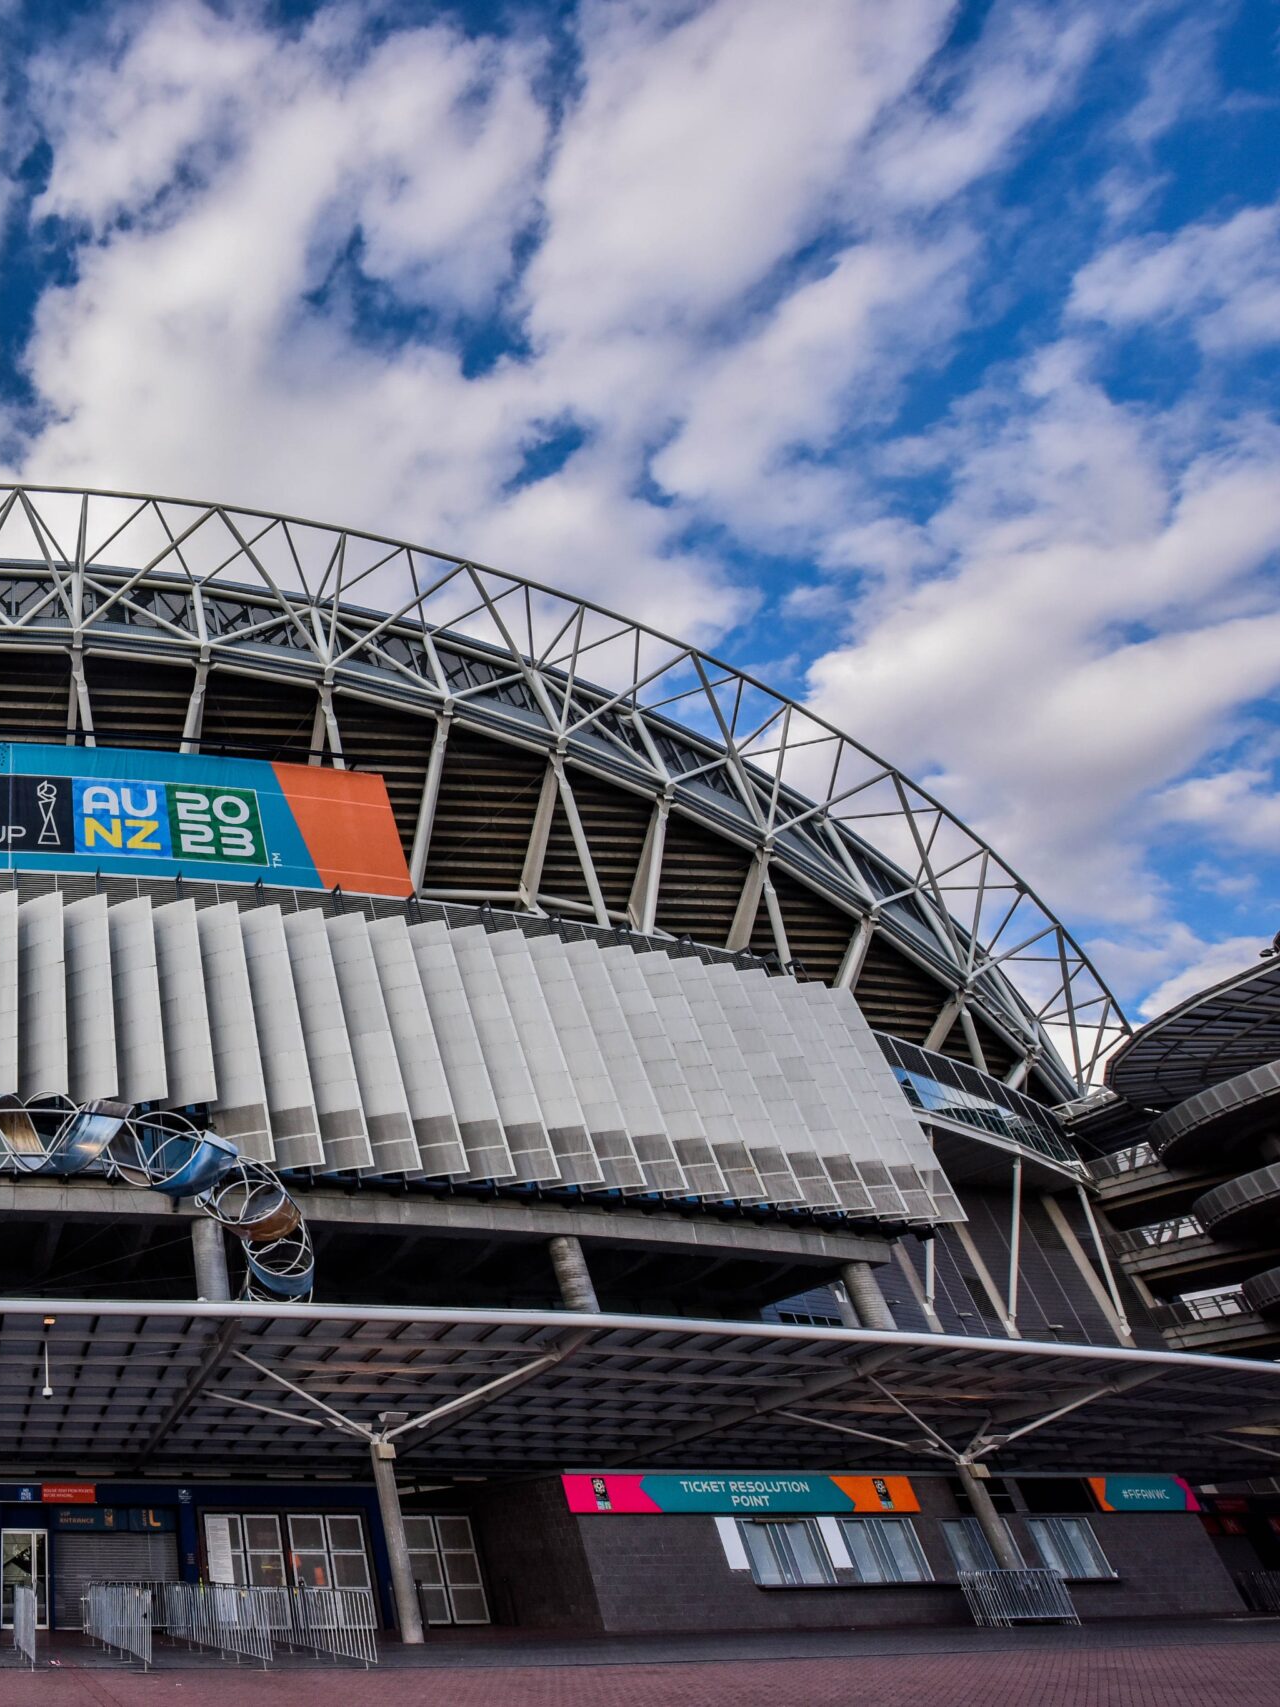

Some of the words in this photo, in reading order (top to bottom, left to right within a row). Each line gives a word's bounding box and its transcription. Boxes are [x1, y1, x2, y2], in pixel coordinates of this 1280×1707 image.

[82, 786, 157, 818] AU
[175, 791, 250, 825] 20
[84, 817, 161, 850] NZ
[179, 822, 256, 858] 23
[679, 1480, 726, 1493] TICKET
[729, 1481, 810, 1494] RESOLUTION
[1121, 1488, 1171, 1500] #FIFAWWC
[731, 1495, 770, 1507] POINT
[148, 1509, 161, 1527] L
